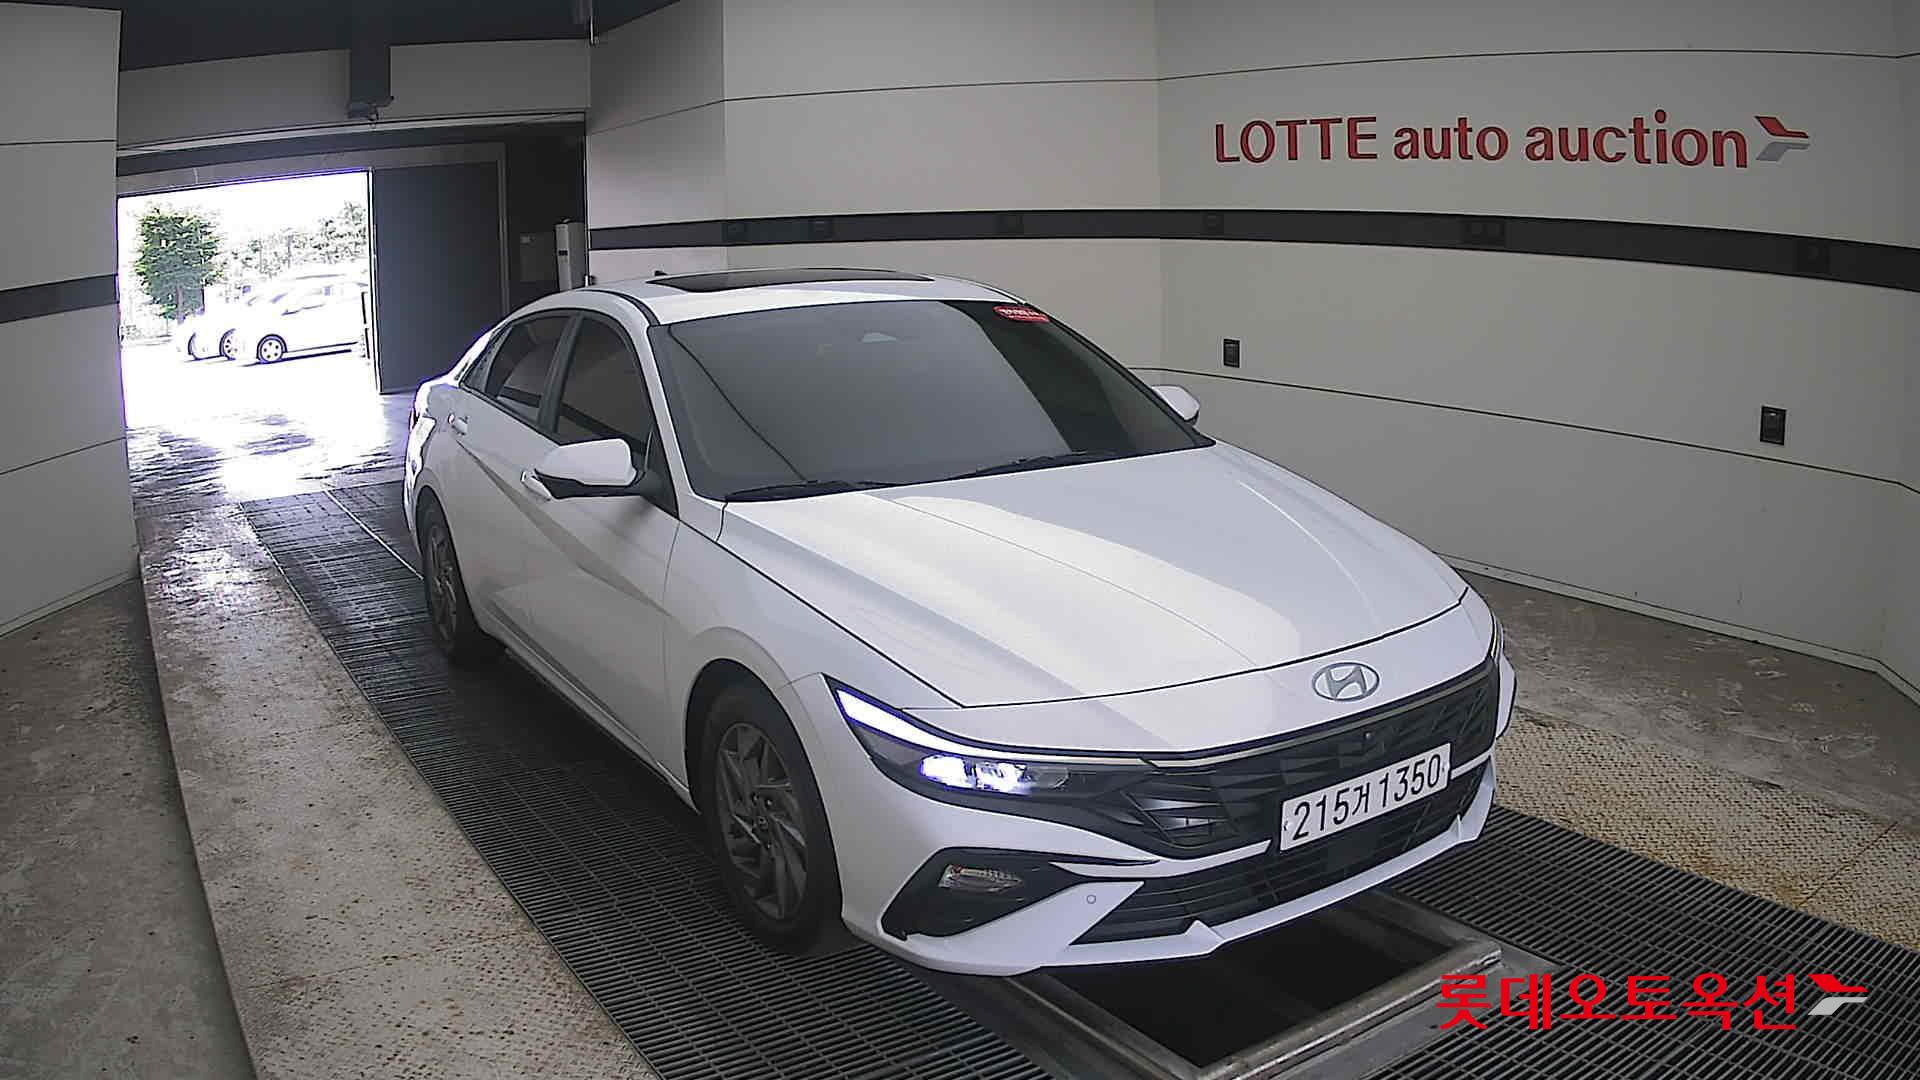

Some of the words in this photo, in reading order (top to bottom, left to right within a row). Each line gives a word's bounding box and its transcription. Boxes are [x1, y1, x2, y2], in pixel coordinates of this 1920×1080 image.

[1214, 116, 1377, 164] LOTTE
[1394, 116, 1509, 162] auto
[1524, 109, 1749, 169] auction
[1379, 753, 1441, 808] 1350
